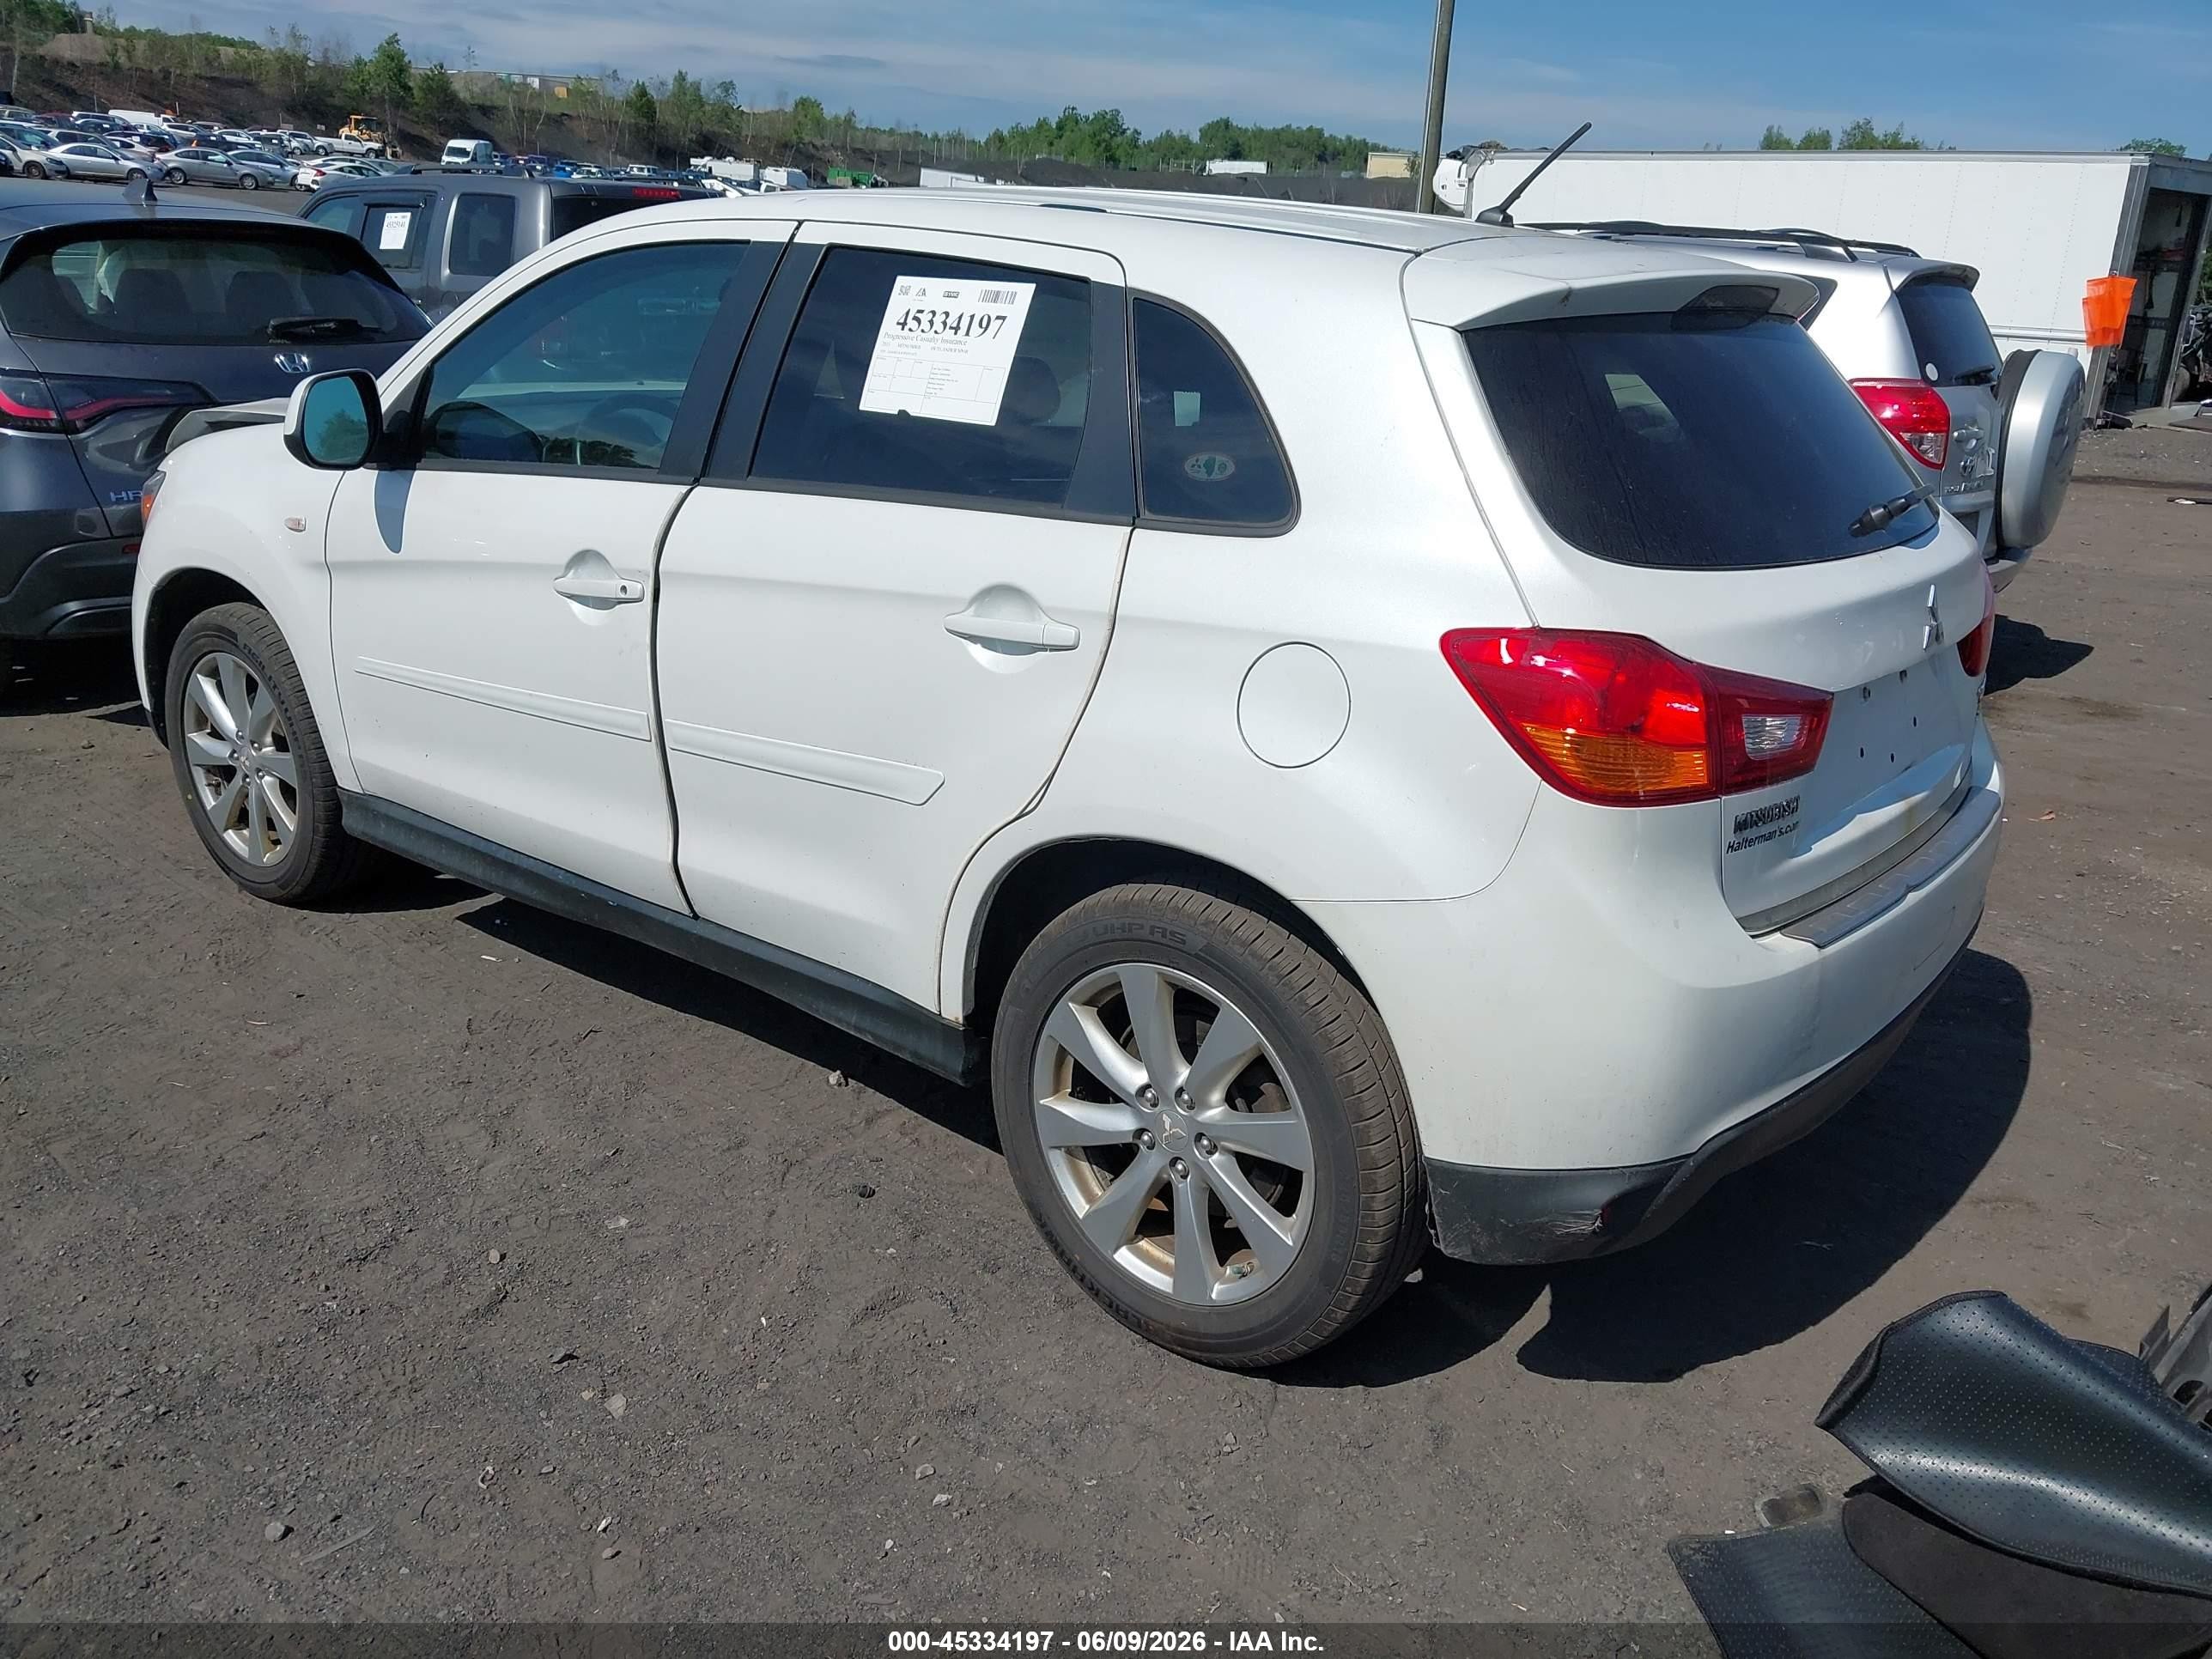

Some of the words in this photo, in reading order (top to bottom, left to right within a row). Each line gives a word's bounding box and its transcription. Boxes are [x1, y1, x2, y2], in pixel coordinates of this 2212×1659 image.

[896, 307, 1008, 340] 45334197
[884, 332, 915, 342] Progressive
[915, 334, 939, 344] Casualty
[940, 337, 968, 346] Insurance
[1150, 925, 1186, 945] AS
